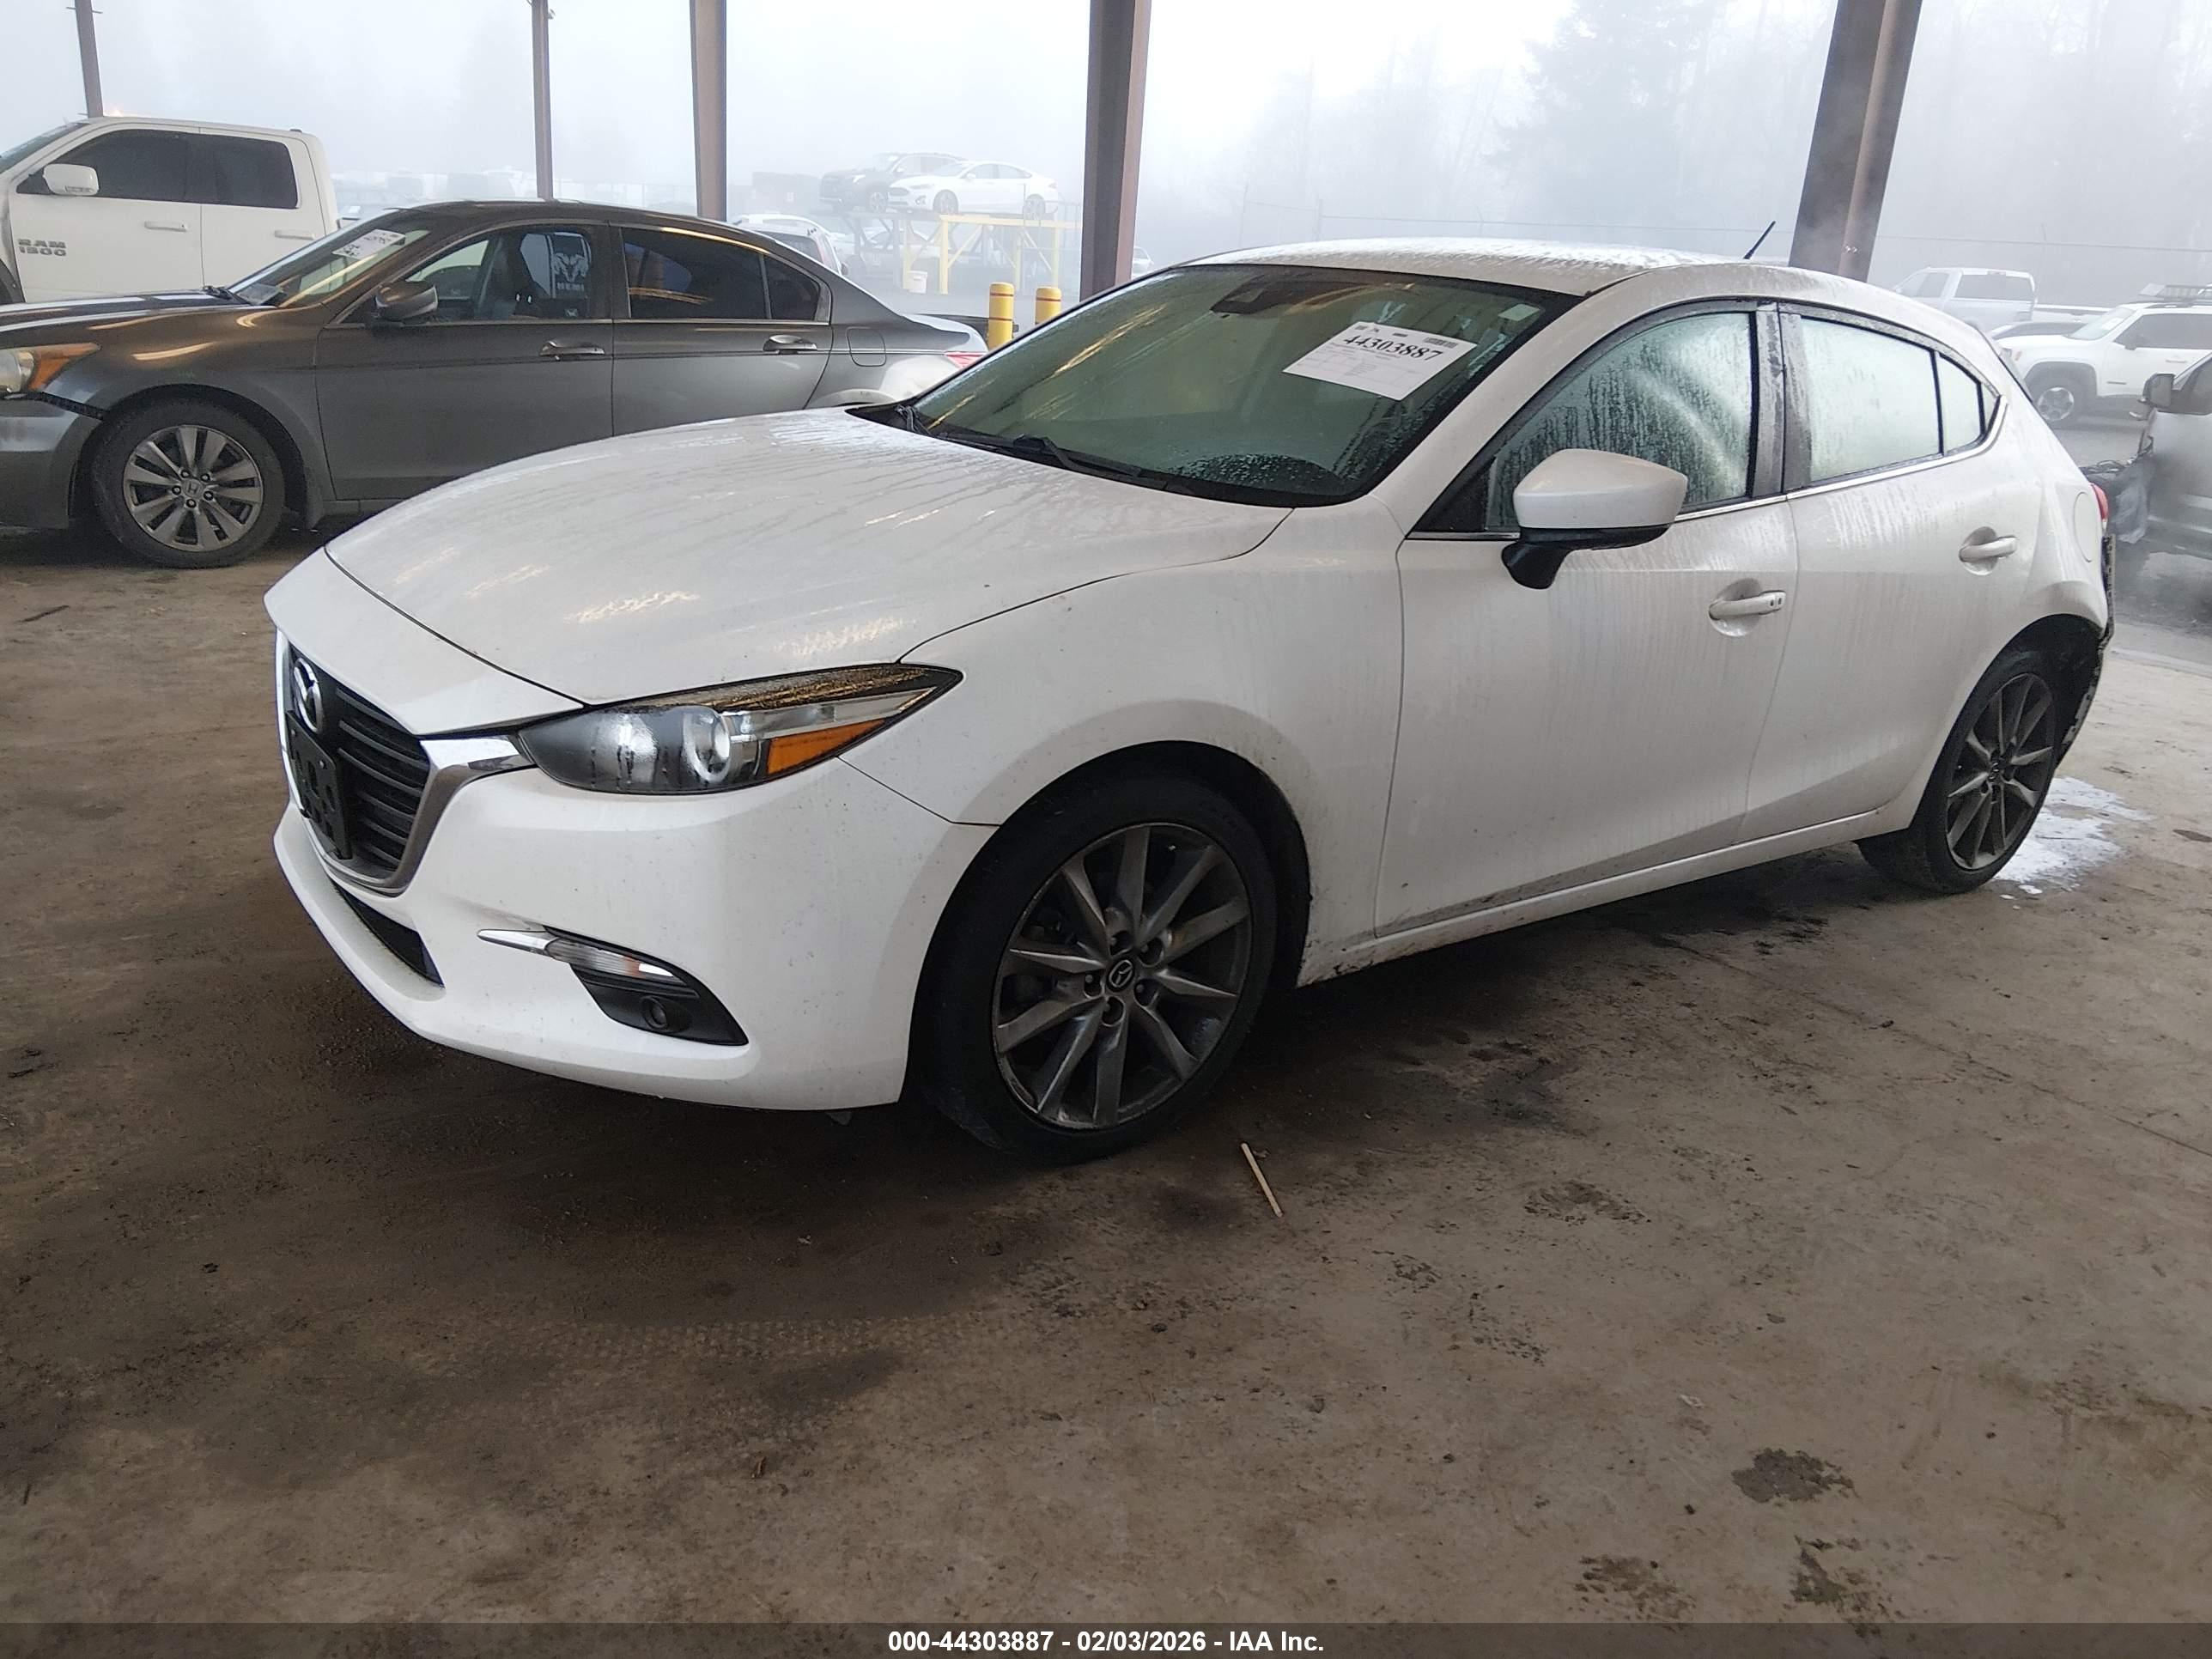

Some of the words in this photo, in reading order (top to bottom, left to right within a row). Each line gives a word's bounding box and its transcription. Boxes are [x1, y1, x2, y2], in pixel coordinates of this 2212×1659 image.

[18, 239, 67, 249] RAM
[19, 246, 67, 257] 1500
[1344, 335, 1444, 361] 44303887
